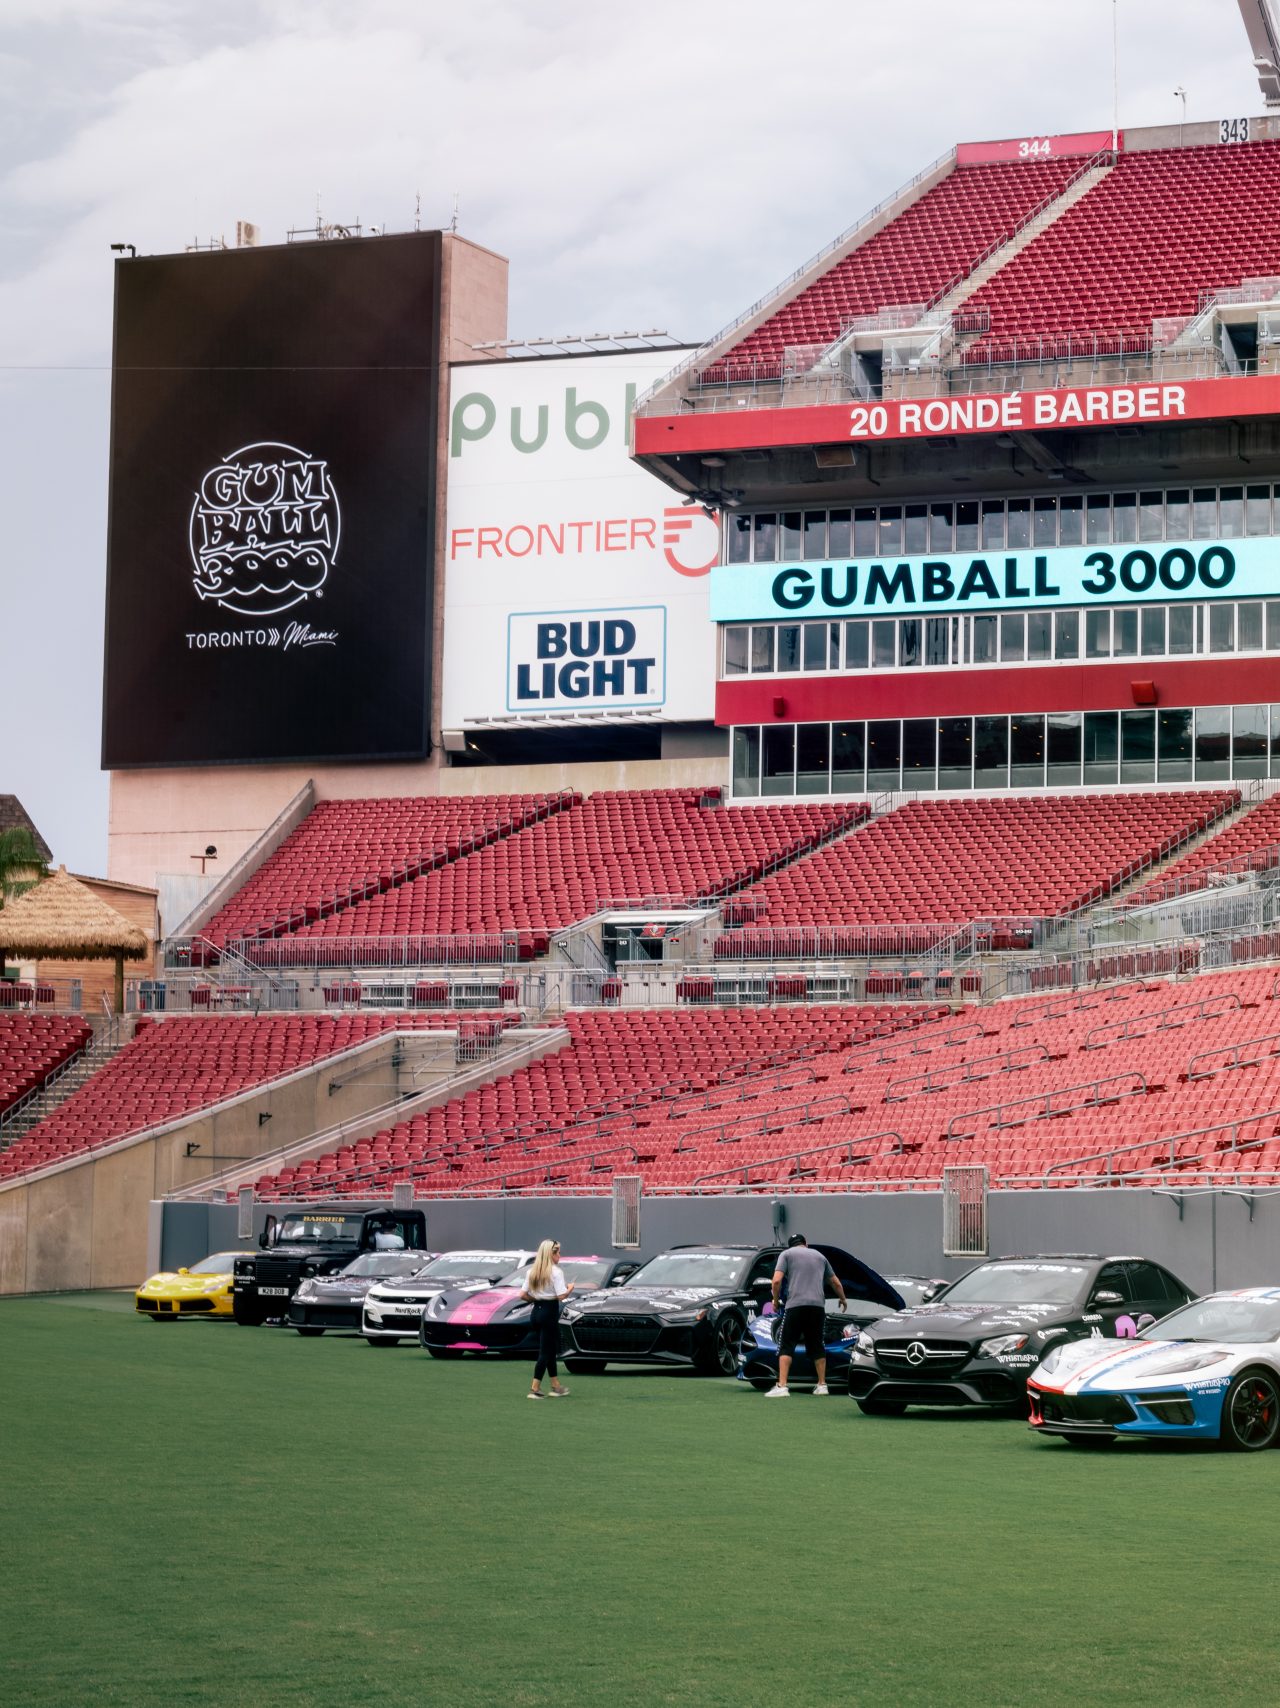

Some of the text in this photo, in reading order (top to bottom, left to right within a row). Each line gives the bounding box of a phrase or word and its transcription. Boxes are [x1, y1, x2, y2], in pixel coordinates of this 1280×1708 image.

[1019, 140, 1051, 157] 344
[1221, 118, 1248, 143] 343
[850, 385, 1187, 437] 20 RONDÉ BARBER
[201, 460, 330, 509] GUM
[198, 502, 331, 554] BALL
[451, 518, 656, 560] FRONTIER
[194, 547, 328, 600] 3000
[771, 546, 1236, 610] GUMBALL 3000
[186, 621, 339, 651] TORONTO Miami
[537, 619, 636, 659] BUD
[517, 658, 656, 700] LIGHT
